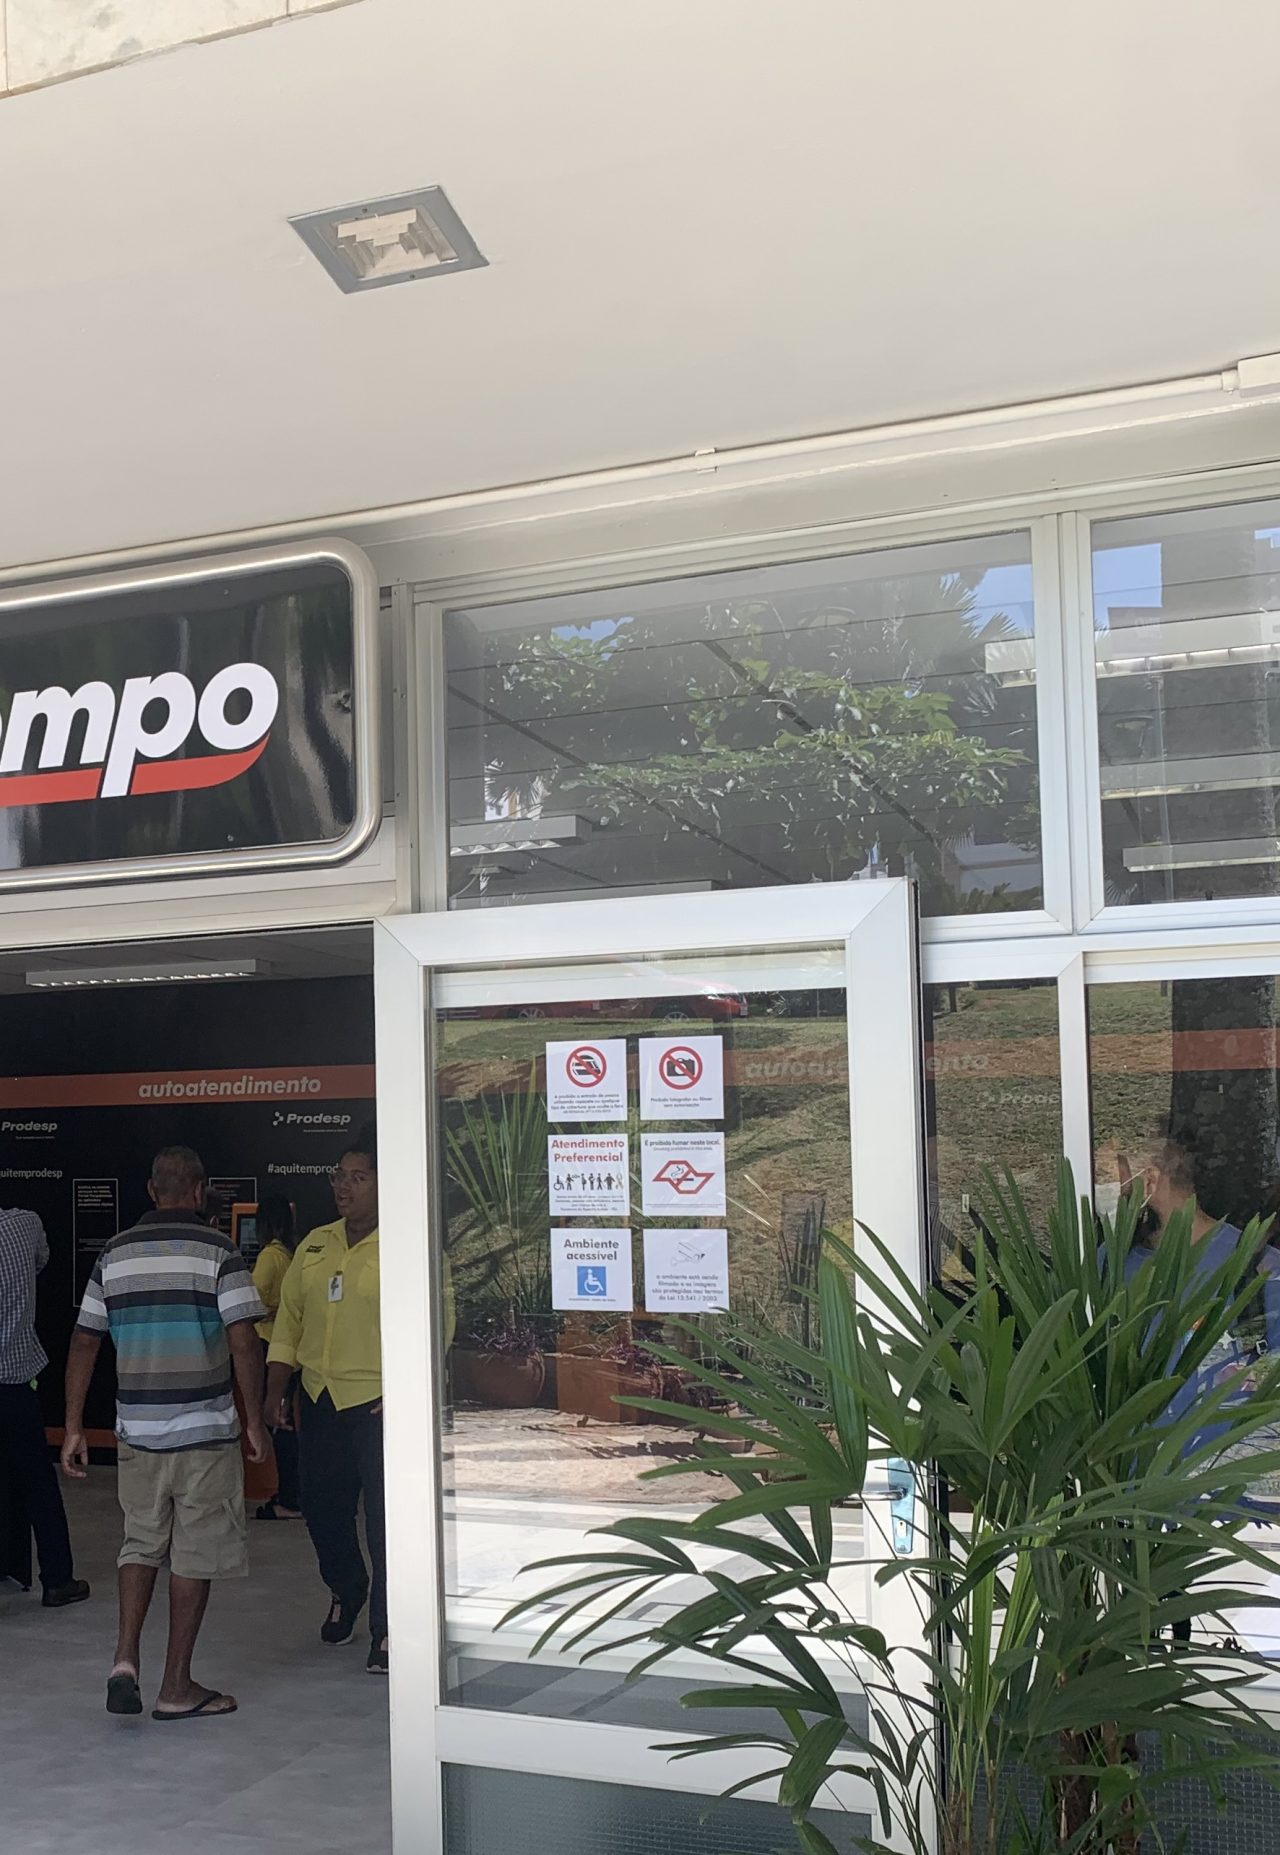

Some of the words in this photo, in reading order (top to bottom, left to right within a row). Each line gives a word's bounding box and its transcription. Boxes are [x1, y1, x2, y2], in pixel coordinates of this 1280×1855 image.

[138, 1075, 321, 1098] autoatendimento
[287, 1112, 351, 1125] Prodesp
[1, 1121, 58, 1132] Prodesp
[551, 1139, 625, 1149] Atendimento
[554, 1152, 623, 1162] Preferencial
[563, 1239, 619, 1248] Ambiente
[566, 1250, 617, 1260] acessível
